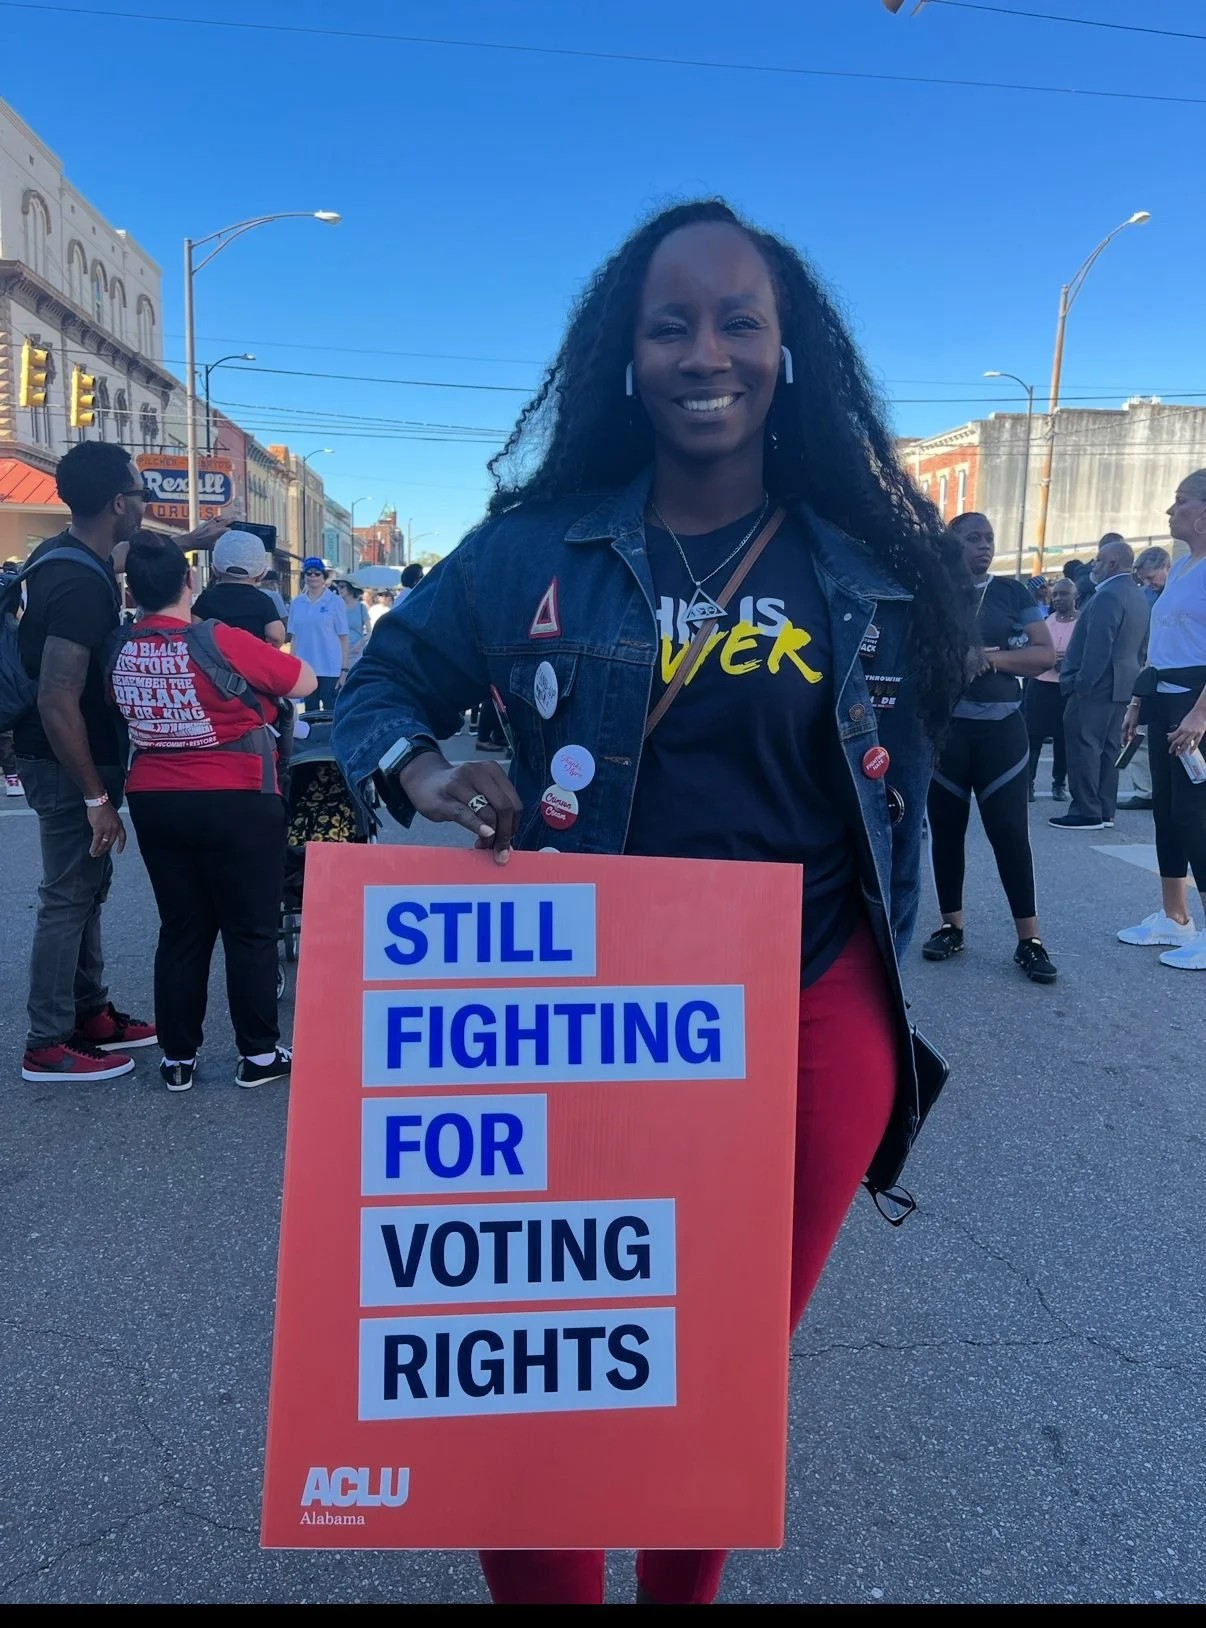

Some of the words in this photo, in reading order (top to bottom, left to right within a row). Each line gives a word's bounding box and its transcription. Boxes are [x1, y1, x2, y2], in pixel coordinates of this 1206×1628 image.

[158, 505, 214, 518] DRUS
[740, 596, 788, 638] IS
[660, 620, 824, 687] WER
[860, 644, 876, 652] ACK
[114, 686, 200, 708] DREAM
[168, 678, 194, 689] THE
[164, 707, 205, 720] KING
[384, 900, 572, 965] STILL
[387, 1000, 722, 1069] FIGHTING
[385, 1112, 524, 1179] FOR
[380, 1215, 651, 1288] VOTING
[383, 1323, 650, 1400] RIGHTS
[300, 1467, 410, 1507] ACLU
[300, 1511, 366, 1526] Alabama
